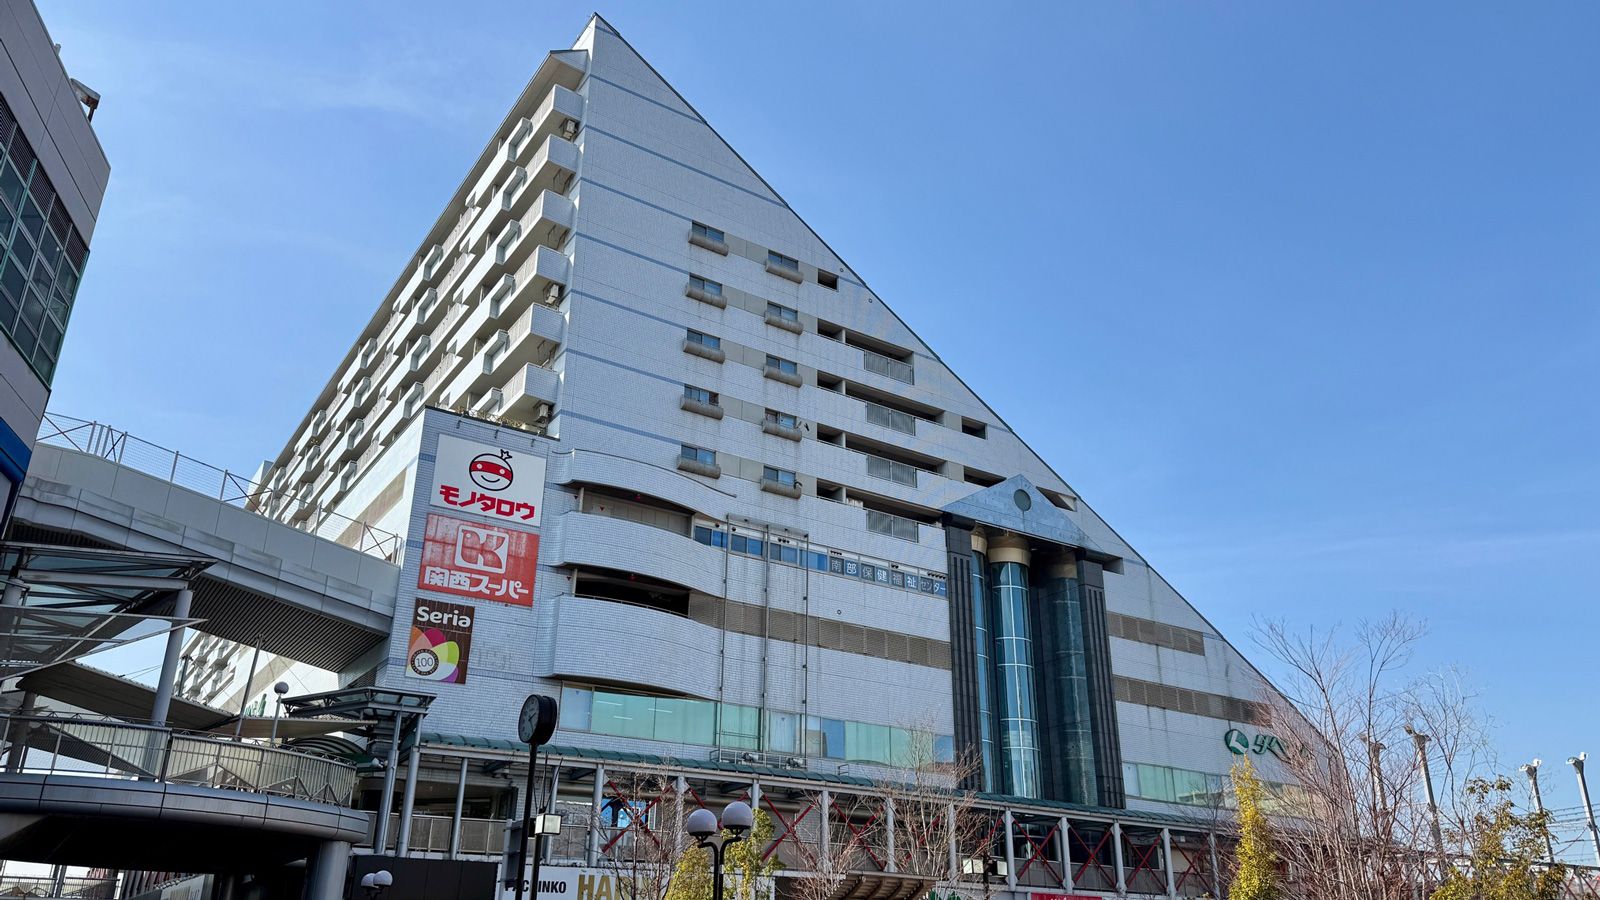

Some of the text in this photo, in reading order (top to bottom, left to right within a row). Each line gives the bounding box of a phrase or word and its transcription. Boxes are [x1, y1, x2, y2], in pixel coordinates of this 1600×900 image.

[440, 485, 535, 520] モノタロウ
[424, 567, 529, 599] 関西スーパー
[831, 560, 946, 593] 南部保健福祉センター
[416, 606, 471, 628] Seria
[416, 657, 434, 668] 100
